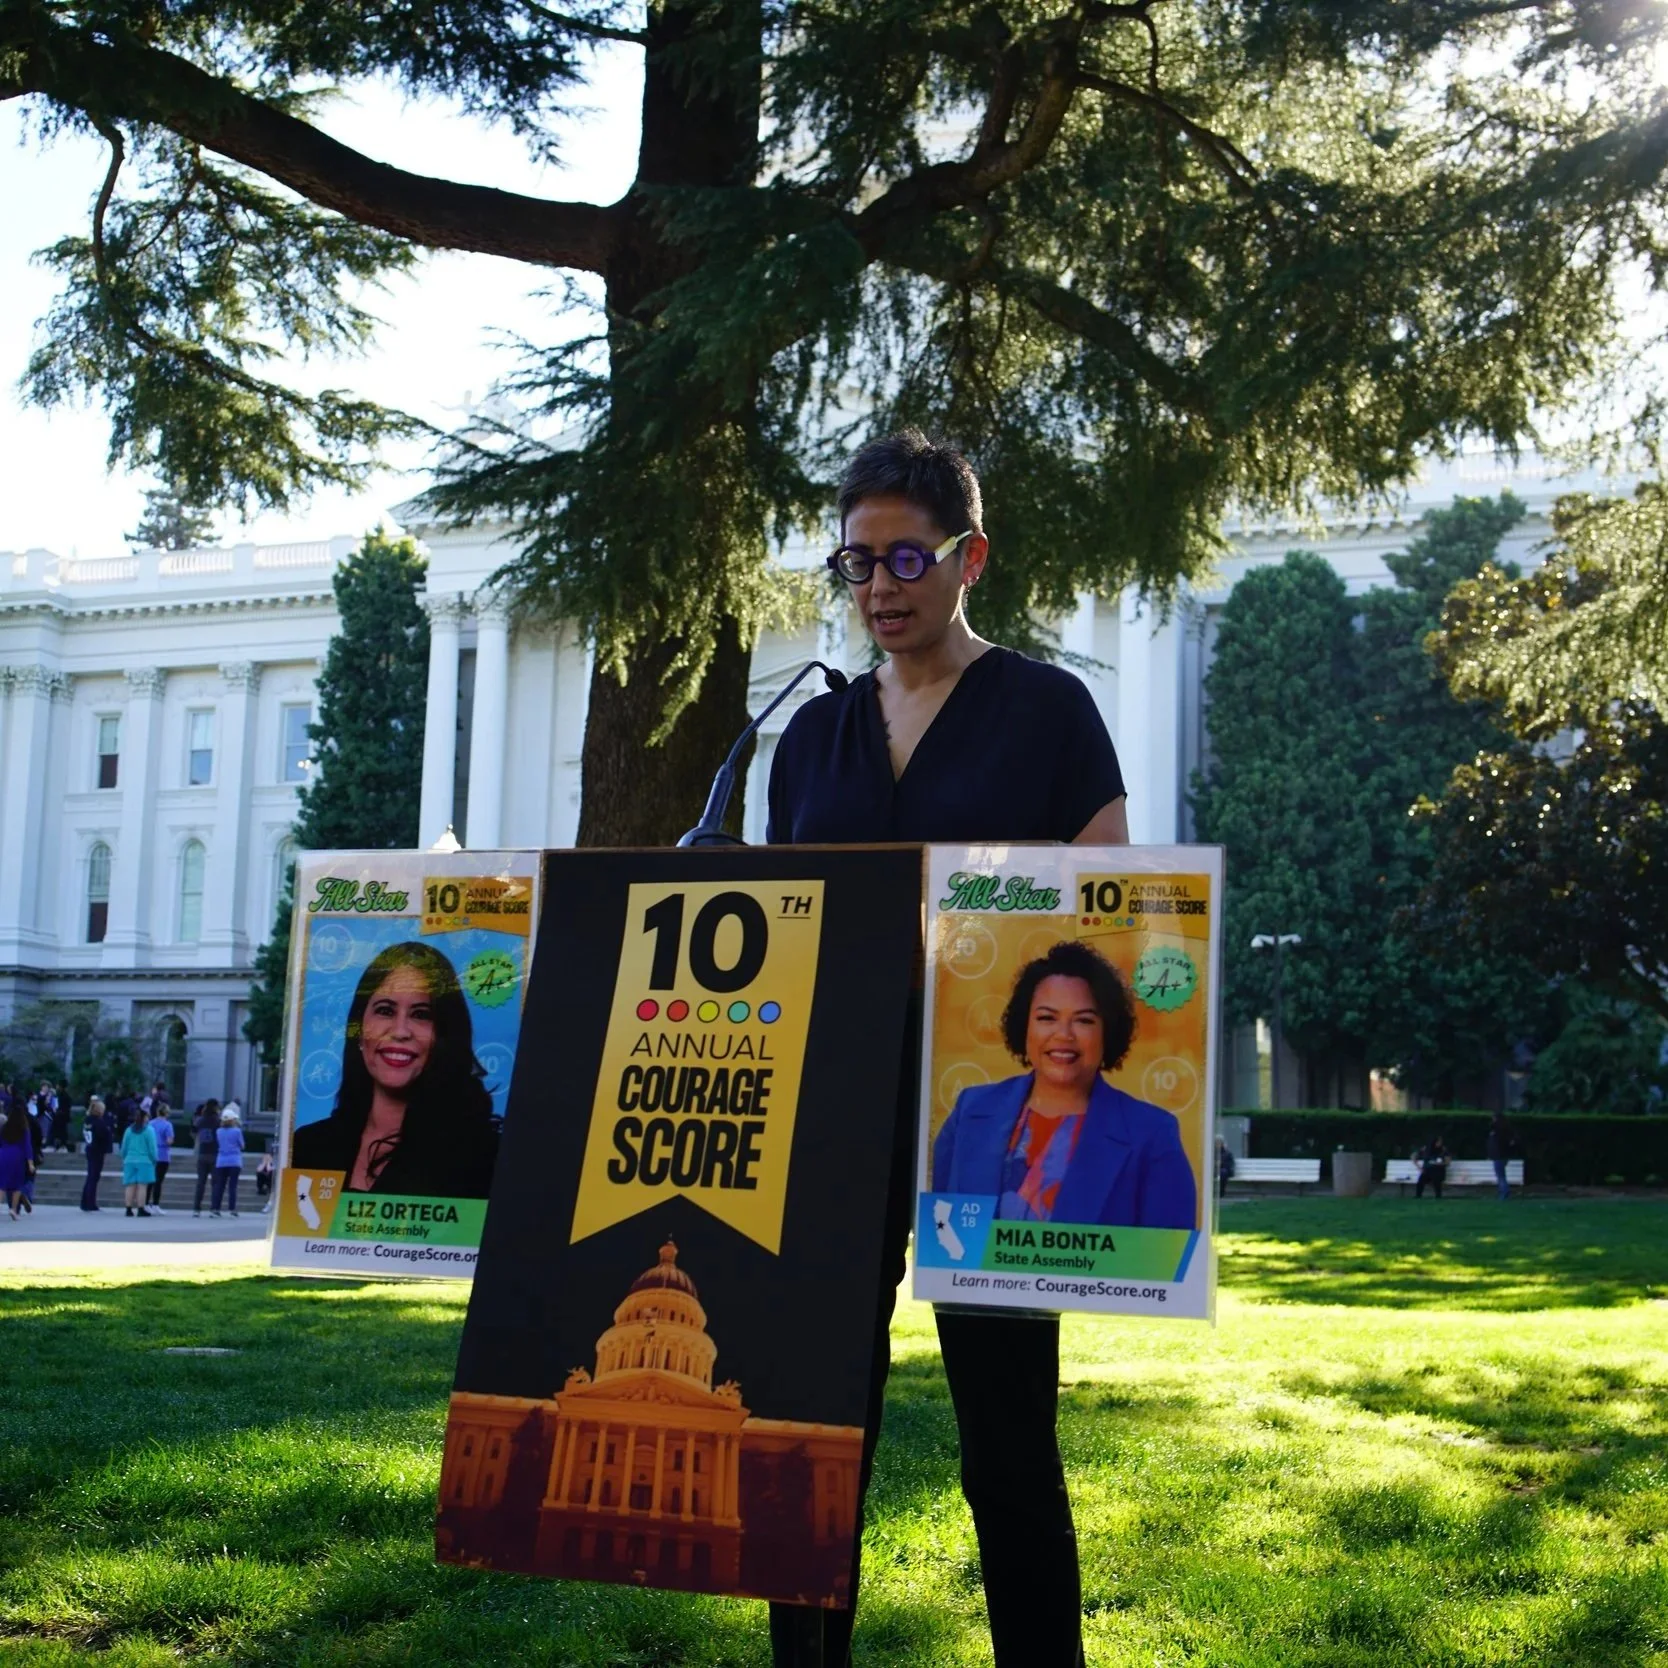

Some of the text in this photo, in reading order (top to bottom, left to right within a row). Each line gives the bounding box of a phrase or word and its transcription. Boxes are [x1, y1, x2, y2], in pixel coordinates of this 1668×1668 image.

[309, 877, 409, 912] All Star
[466, 887, 517, 899] ANNU
[939, 872, 1062, 911] All Star
[1129, 885, 1191, 898] ANNUAL
[1128, 899, 1207, 915] COURAGE SCORE
[630, 1032, 774, 1061] ANNUAL
[617, 1064, 774, 1116] COURAGE
[1152, 1070, 1177, 1091] 10
[607, 1116, 766, 1191] SCORE
[319, 1177, 337, 1189] AD
[319, 1189, 332, 1200] 20
[346, 1201, 459, 1223] LIZ ORTEGA
[960, 1203, 980, 1215] AD
[345, 1221, 430, 1238] State Assembly
[961, 1216, 976, 1228] 18
[995, 1228, 1116, 1252] MIA BONTA
[304, 1240, 478, 1263] Learn more: CourageScore.or
[994, 1251, 1095, 1270] State Assembly
[952, 1273, 1167, 1301] Learn more: CourageScore.org
